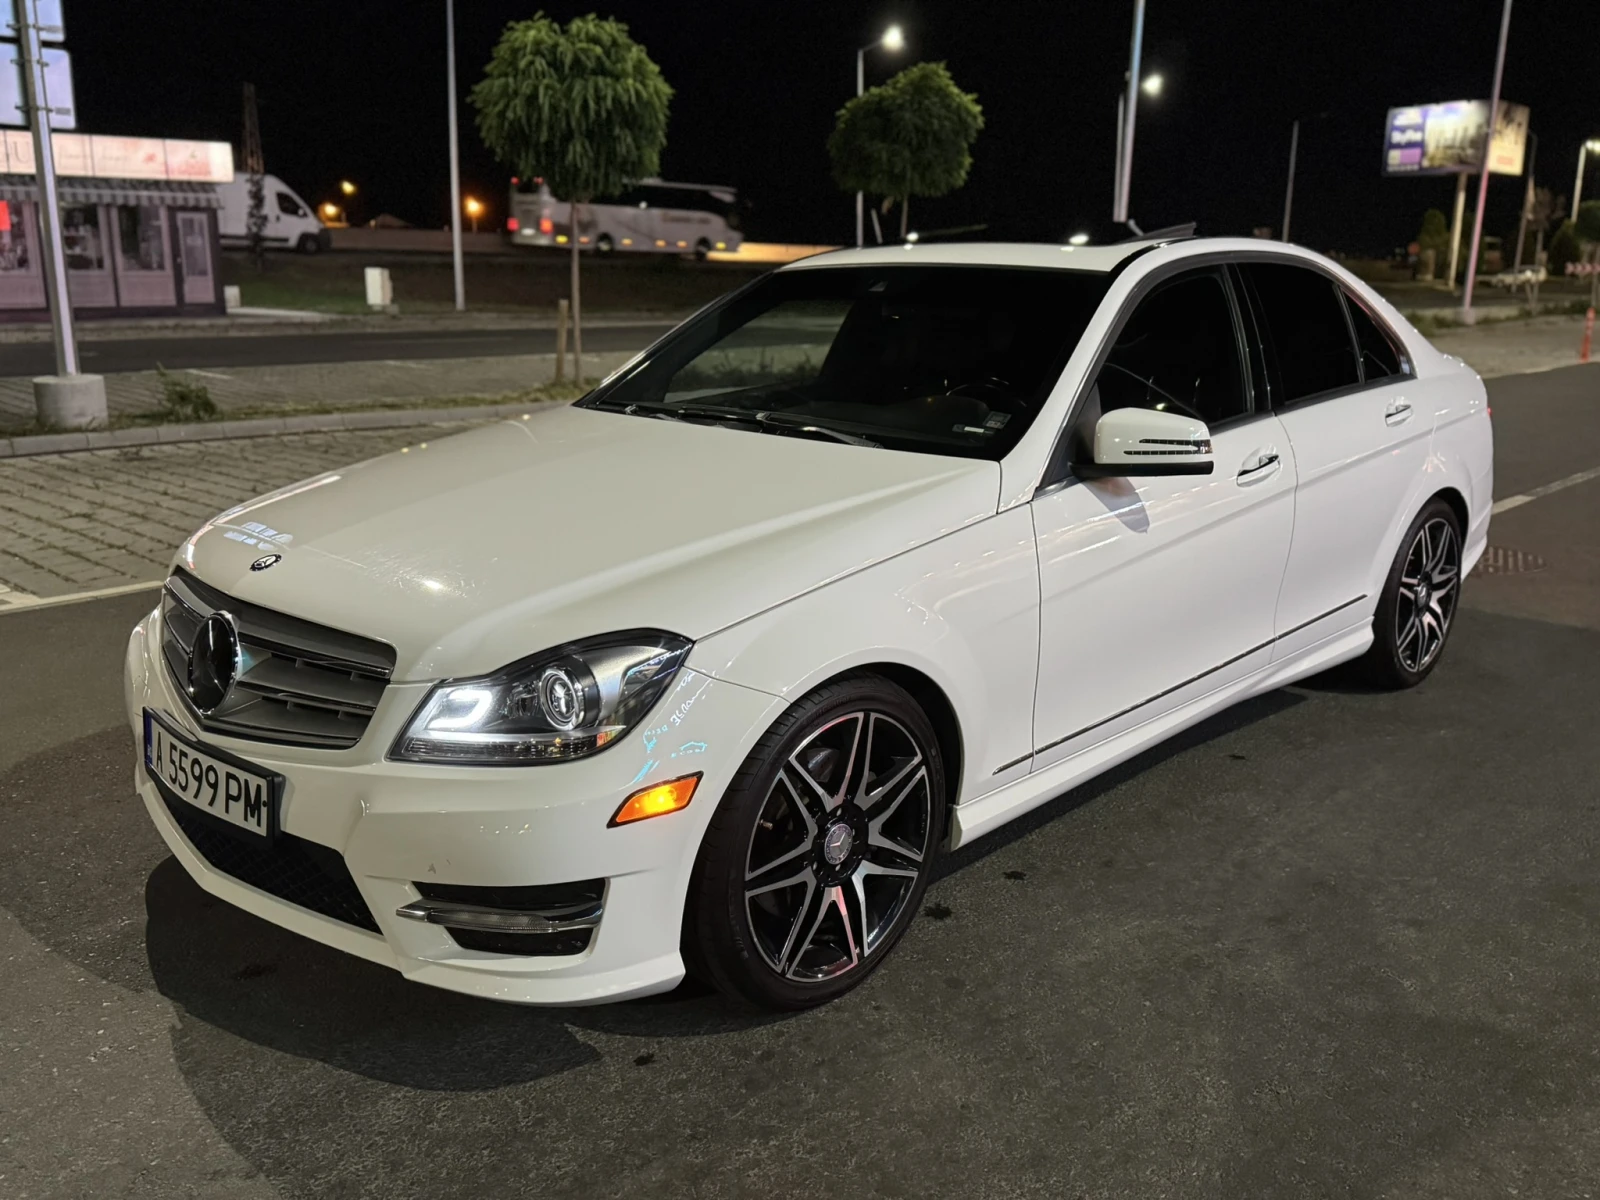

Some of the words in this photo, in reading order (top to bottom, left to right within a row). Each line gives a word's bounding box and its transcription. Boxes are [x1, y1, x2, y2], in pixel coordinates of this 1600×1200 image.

[156, 731, 163, 774] A
[168, 741, 219, 808] 5599
[225, 771, 262, 828] PM
